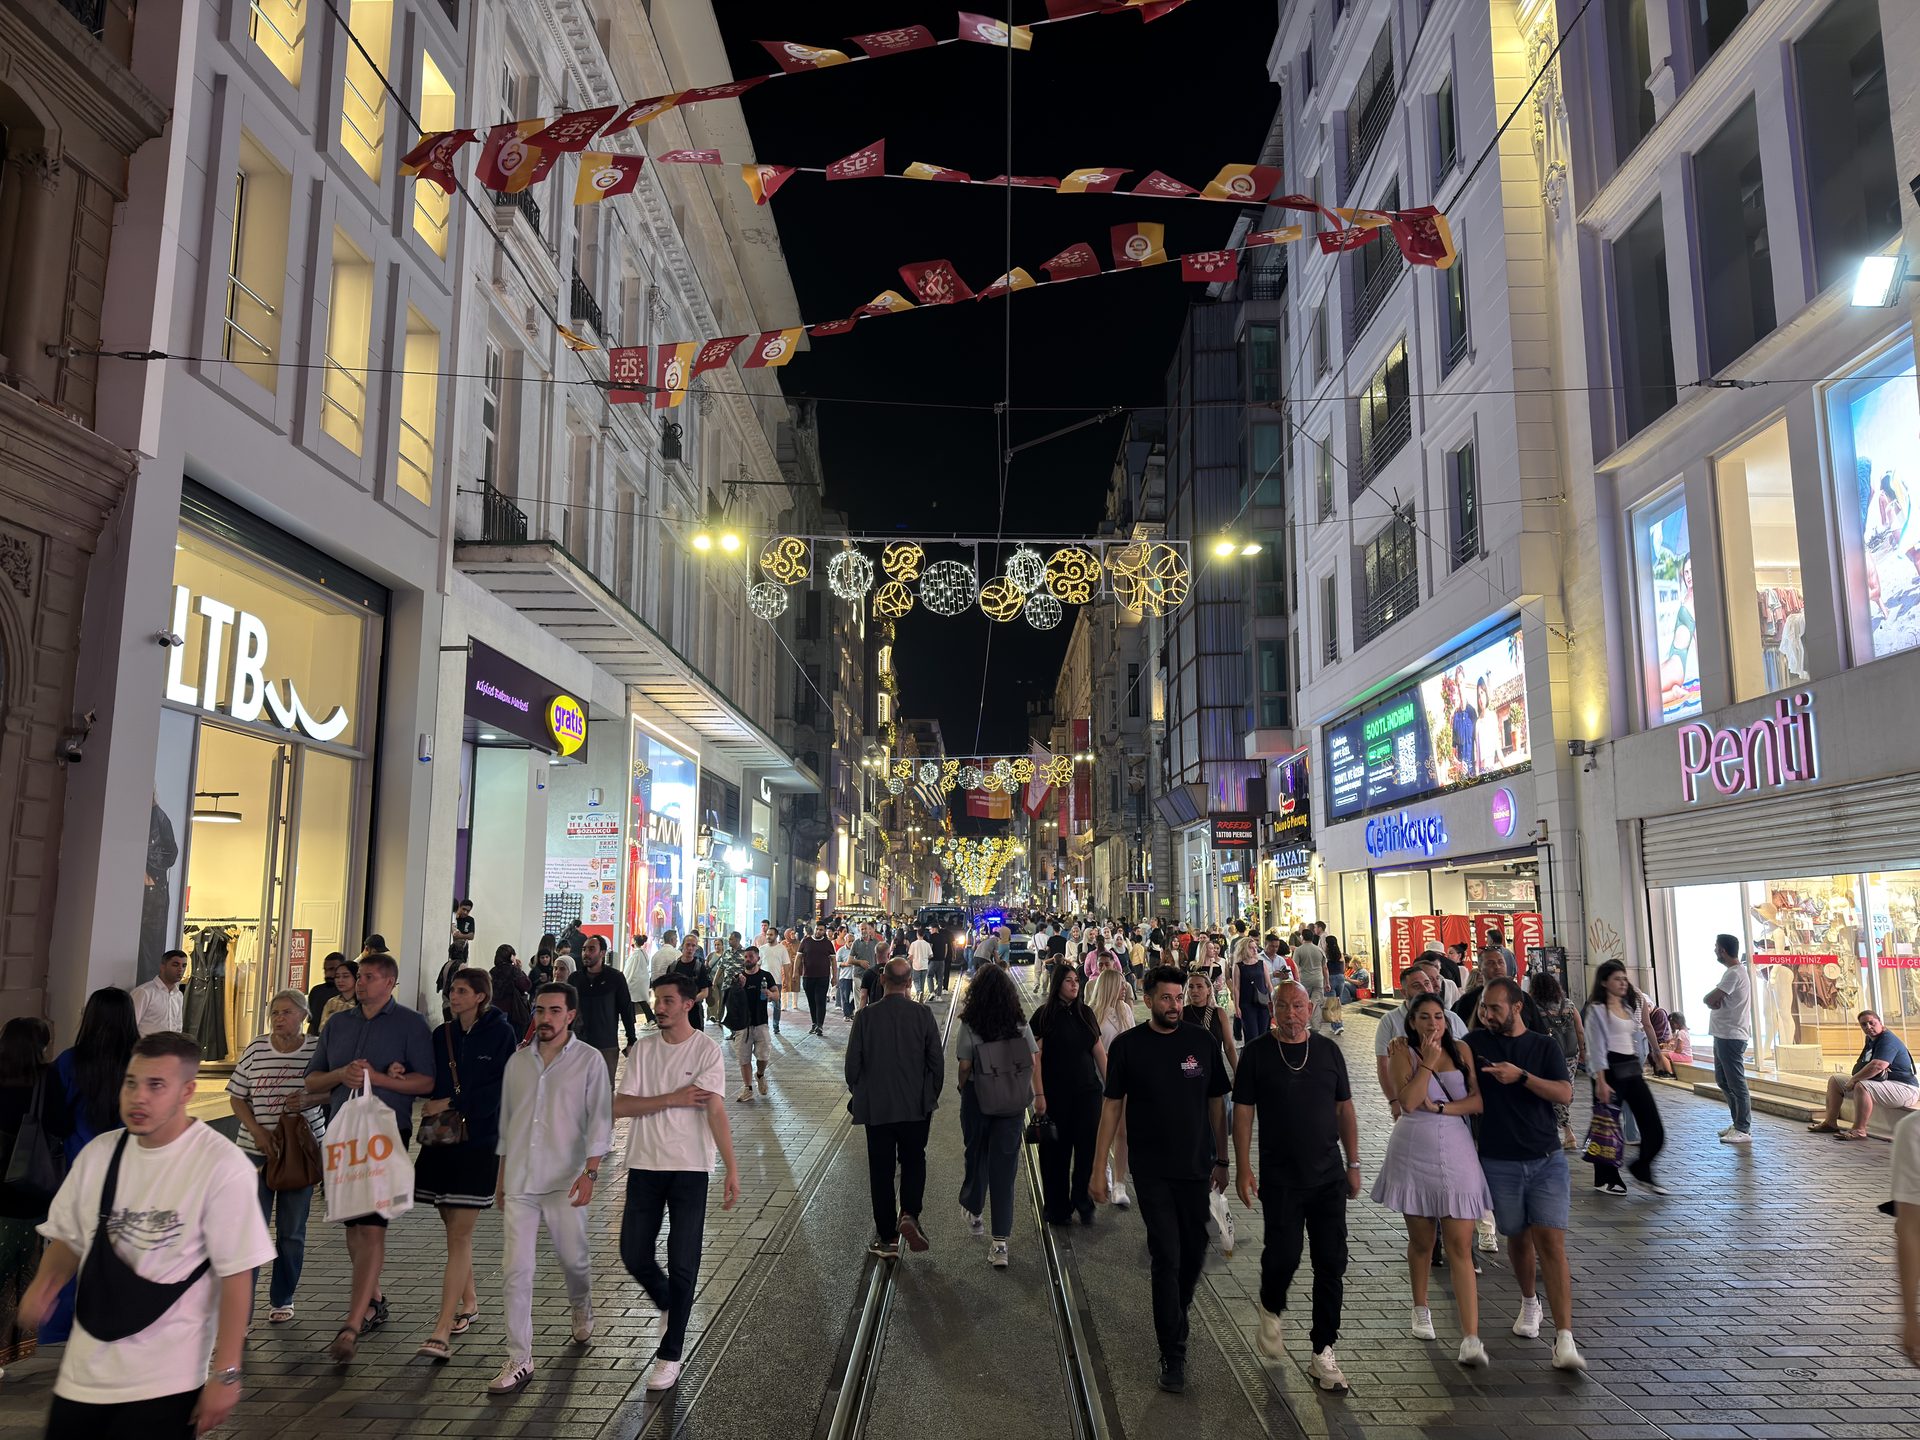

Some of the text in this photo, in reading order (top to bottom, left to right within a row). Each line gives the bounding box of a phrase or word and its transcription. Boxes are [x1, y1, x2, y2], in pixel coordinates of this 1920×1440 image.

[165, 585, 269, 723] LTB
[555, 704, 584, 736] gratis
[1798, 955, 1822, 963] İTİNİZ
[326, 1134, 394, 1172] FLO
